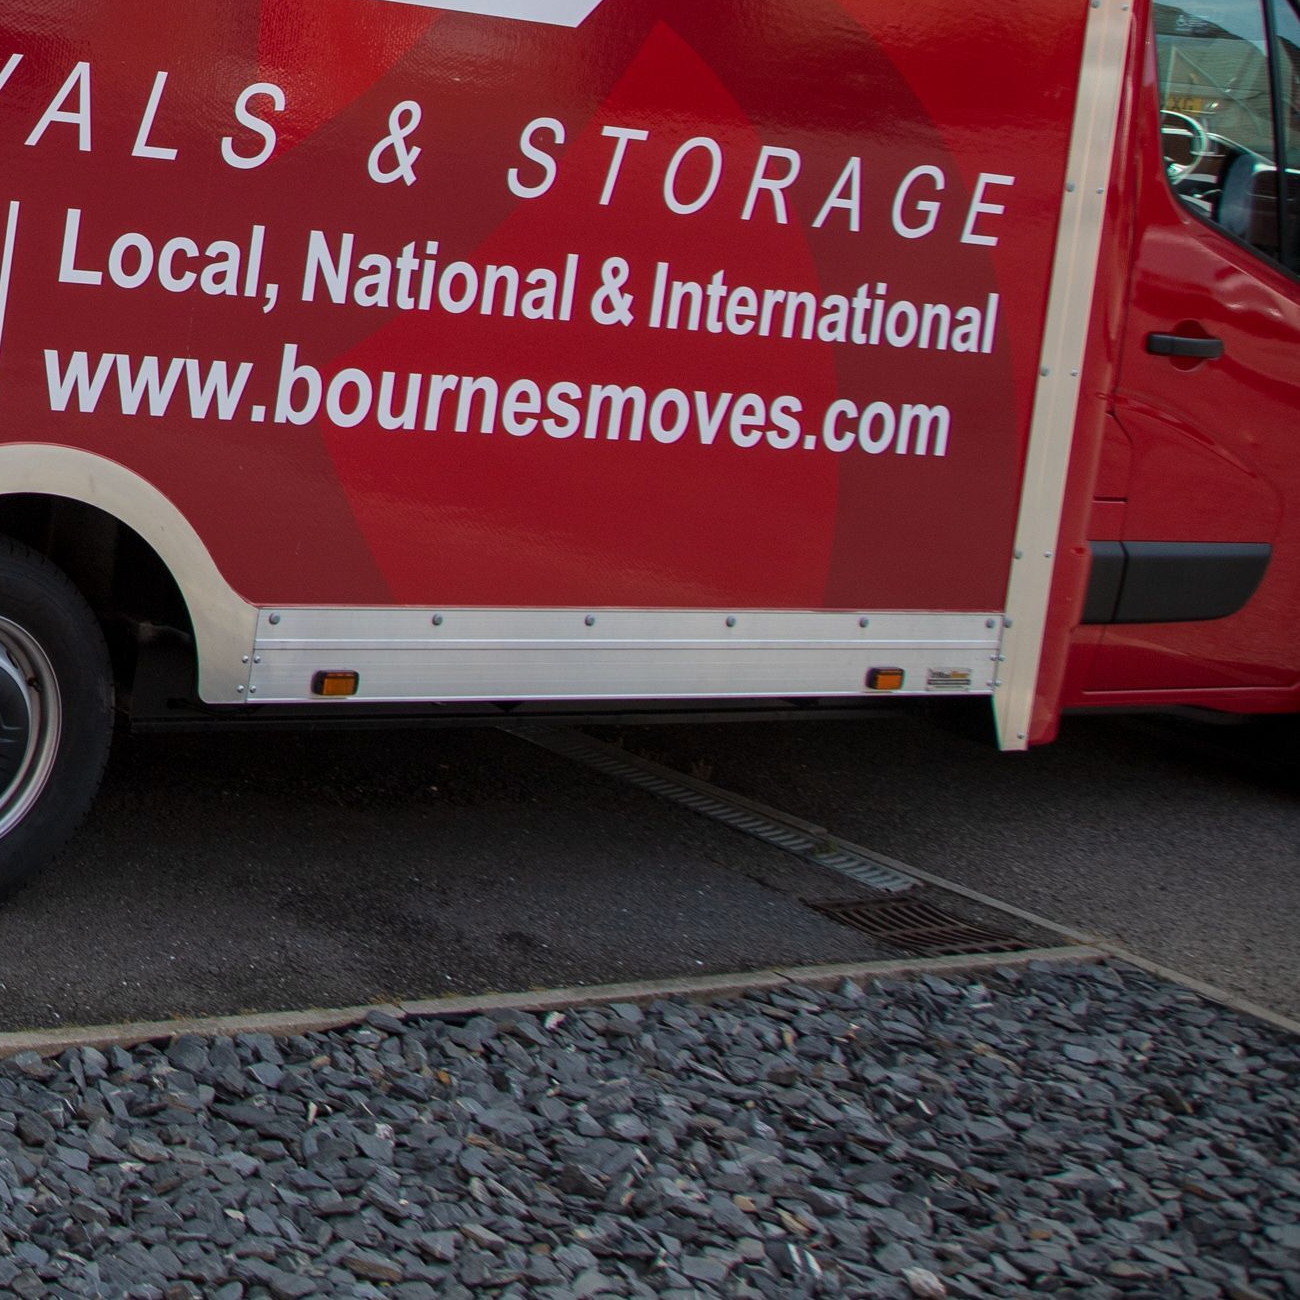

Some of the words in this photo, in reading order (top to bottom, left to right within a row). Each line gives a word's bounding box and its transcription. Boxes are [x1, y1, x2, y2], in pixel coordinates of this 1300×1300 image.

[368, 101, 420, 185] &
[508, 118, 1013, 245] STORAGE
[59, 209, 278, 313] Local,
[302, 231, 578, 322] National
[592, 257, 634, 327] &
[650, 262, 997, 354] International
[45, 344, 949, 456] www.bournesmoves.com
